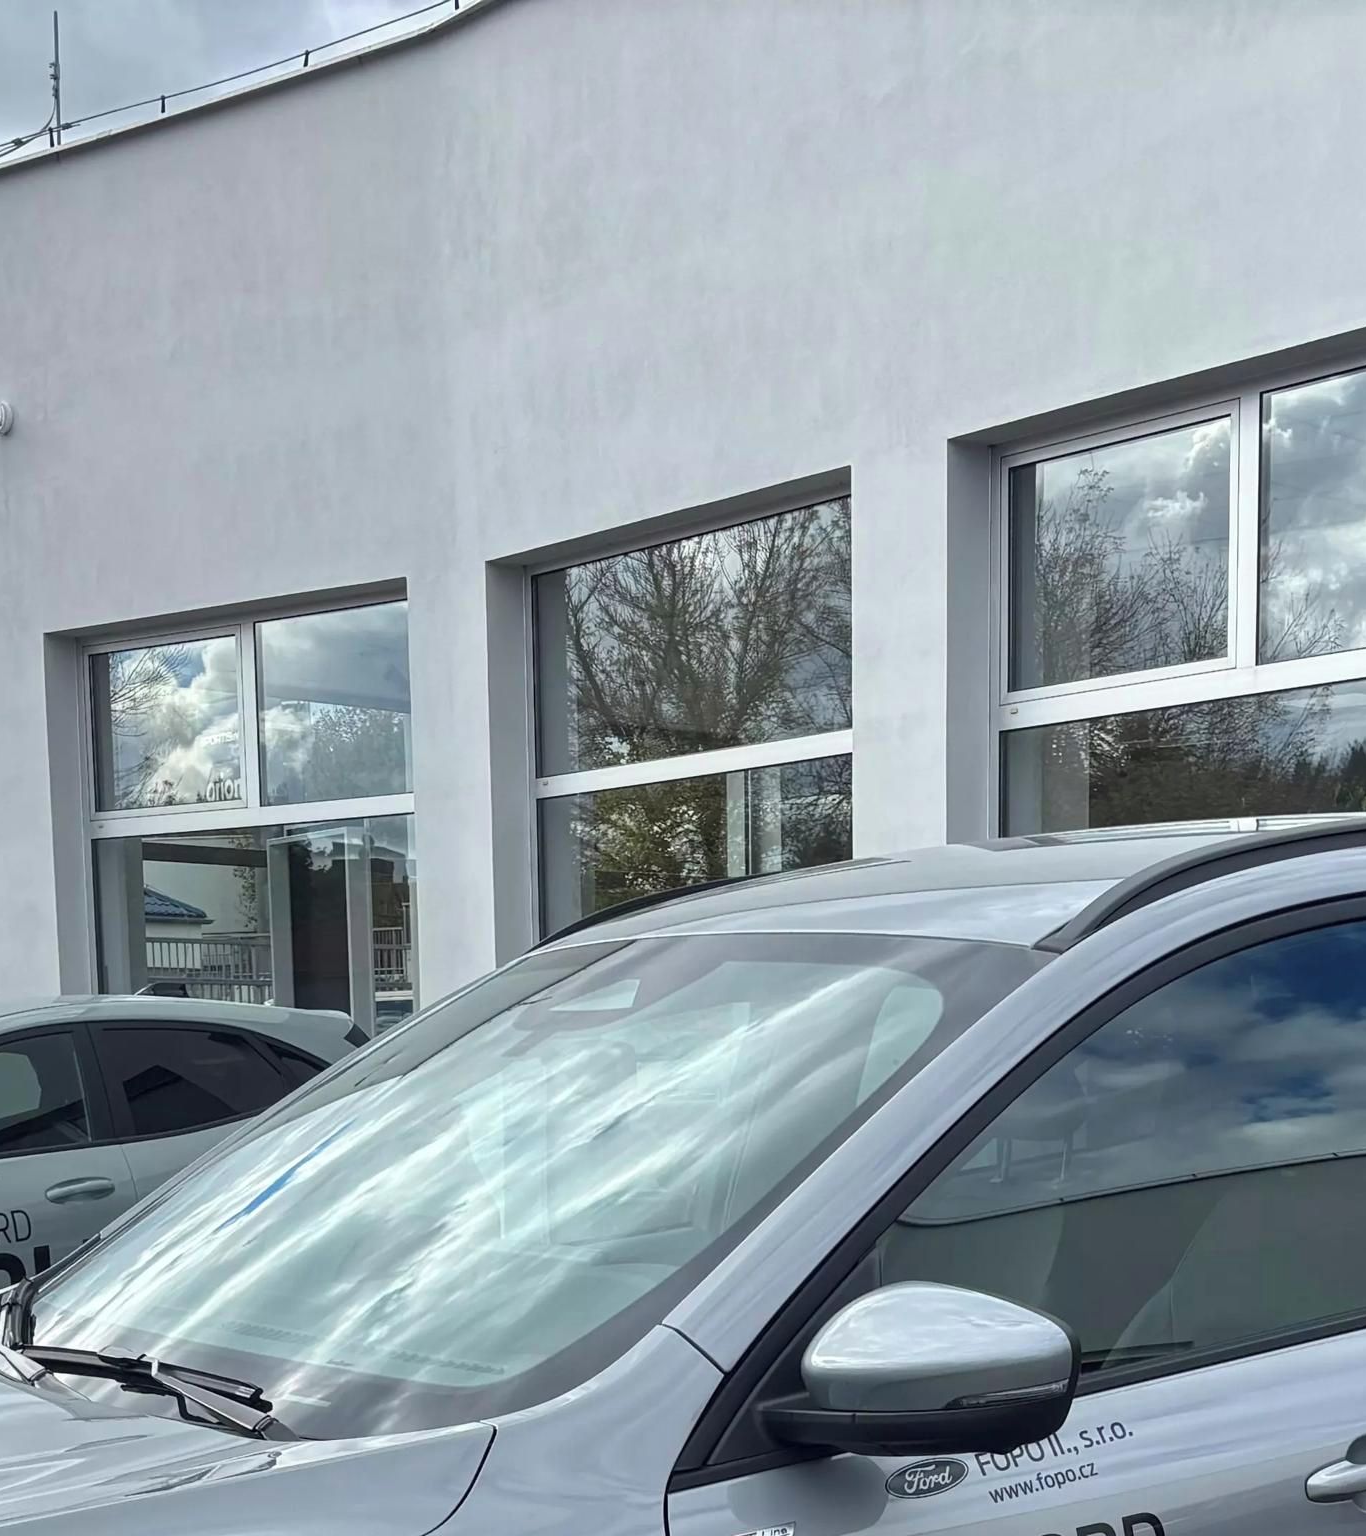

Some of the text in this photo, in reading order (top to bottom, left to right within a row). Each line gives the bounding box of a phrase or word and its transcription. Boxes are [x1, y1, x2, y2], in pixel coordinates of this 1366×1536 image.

[1080, 1421, 1134, 1449] s.r.o.
[904, 1465, 953, 1494] Ford
[988, 1461, 1099, 1504] www.fopo.cz
